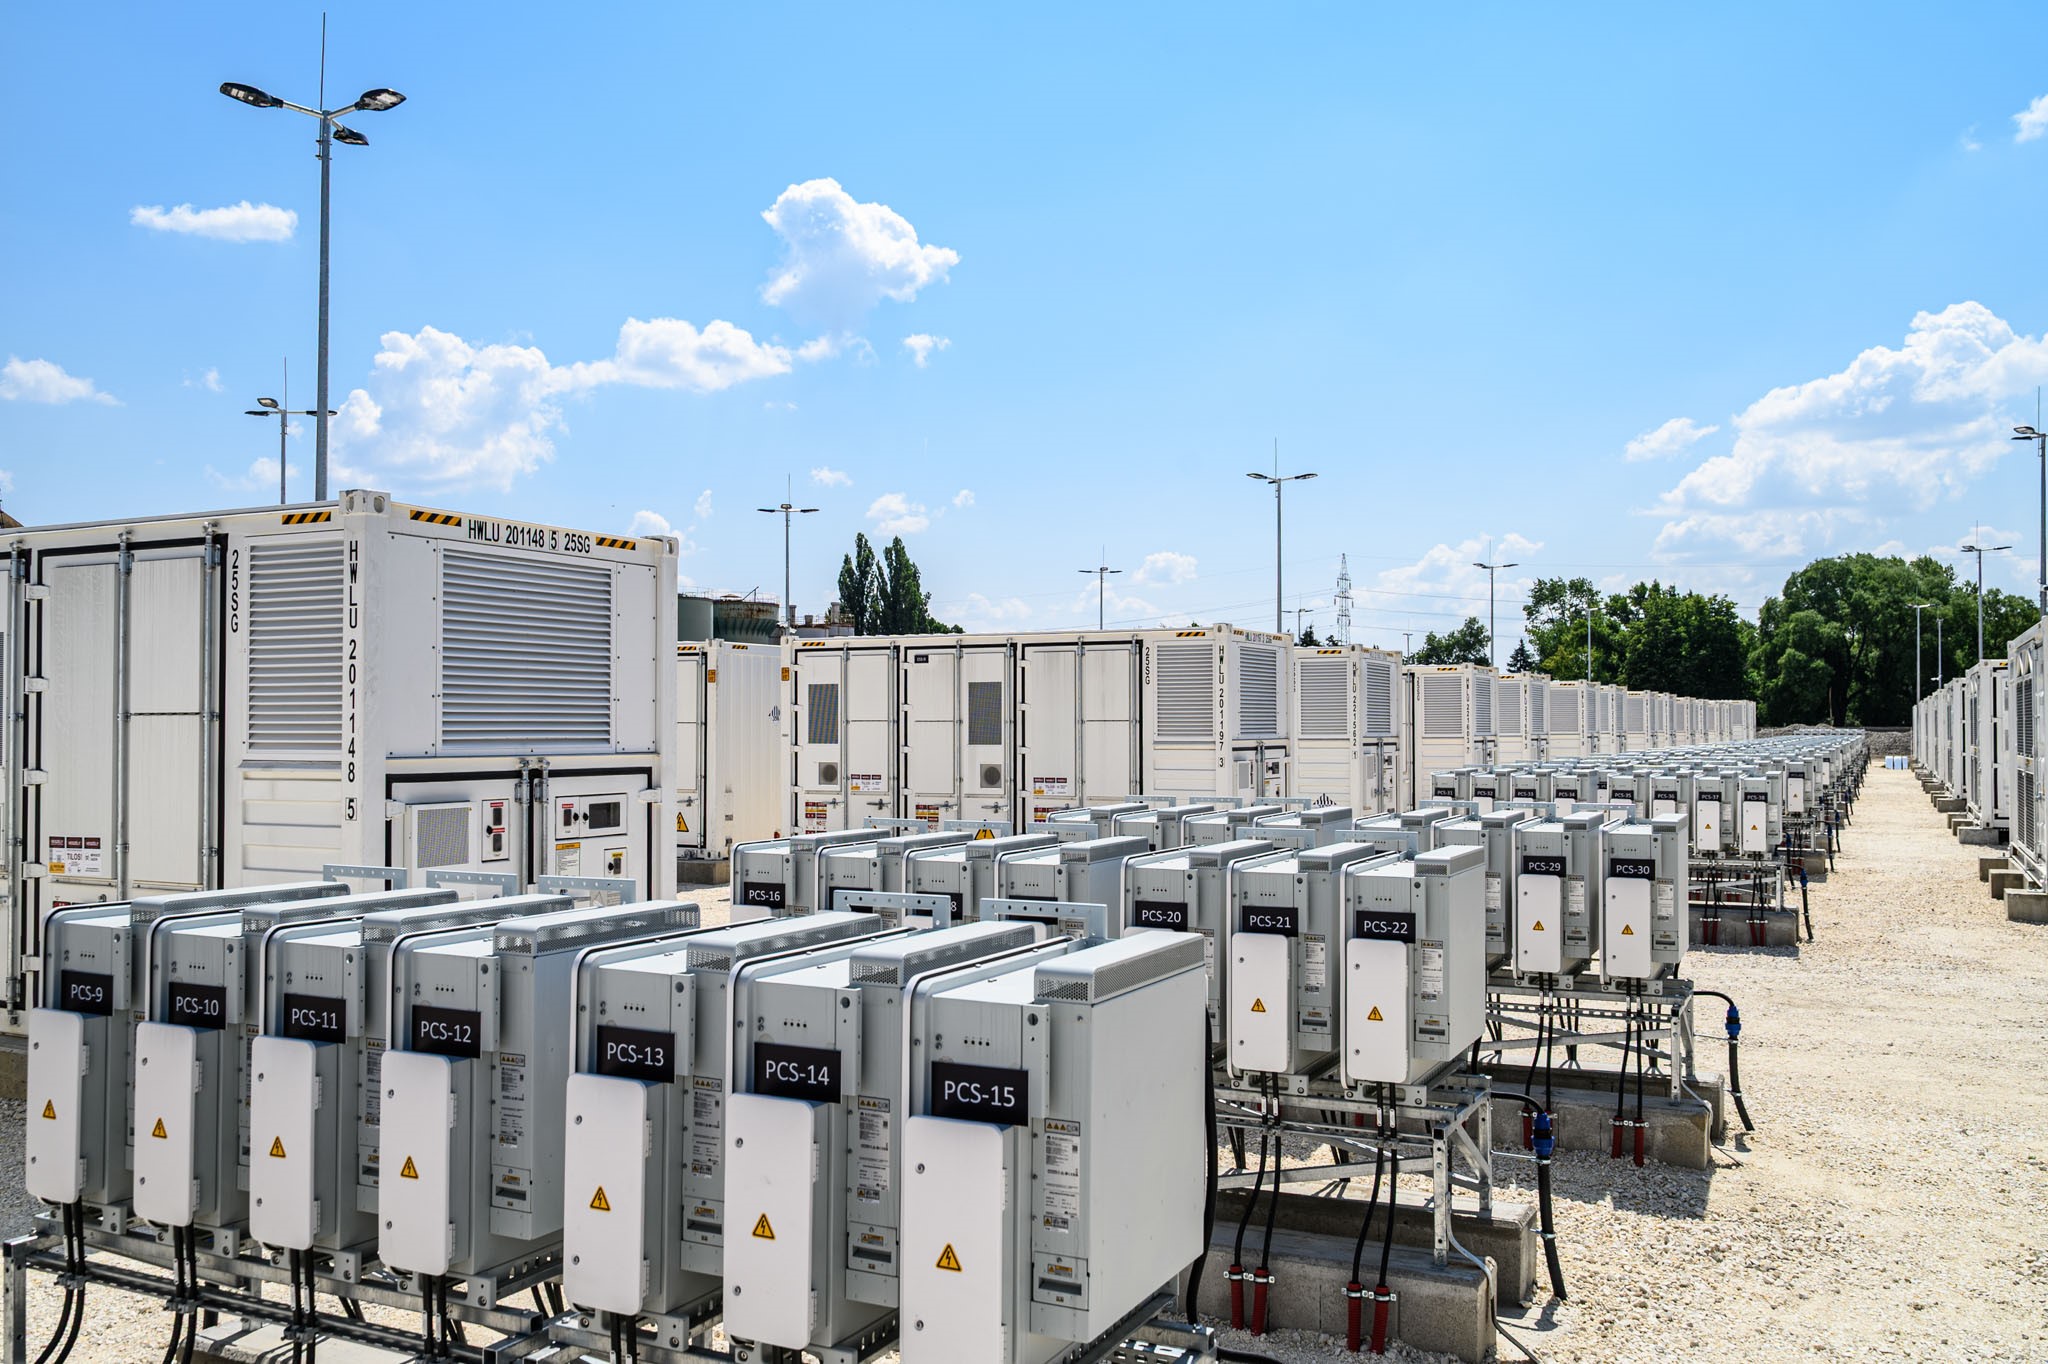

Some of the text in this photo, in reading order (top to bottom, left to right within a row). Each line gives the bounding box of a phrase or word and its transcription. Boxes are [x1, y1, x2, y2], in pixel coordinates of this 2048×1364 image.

[468, 519, 591, 553] HWLU 201148 5 25SG
[231, 549, 239, 633] 25SG
[347, 540, 358, 820] HWLU 201148 5
[1219, 757, 1224, 768] 3
[1528, 862, 1561, 872] PCS-29
[1616, 864, 1650, 875] PCS-30
[749, 889, 781, 902] PCS-16
[1141, 909, 1182, 923] PCS-20
[1249, 915, 1292, 929] PCS-21
[1363, 920, 1408, 934] PCS-22
[70, 983, 103, 1003] PCS-9
[175, 996, 219, 1016] PCS-10
[291, 1008, 338, 1030] PCS-11
[420, 1020, 472, 1043] PCS-12
[606, 1042, 664, 1067] PCS-13
[765, 1060, 830, 1086] PCS-14
[944, 1080, 1016, 1107] PCS-15
